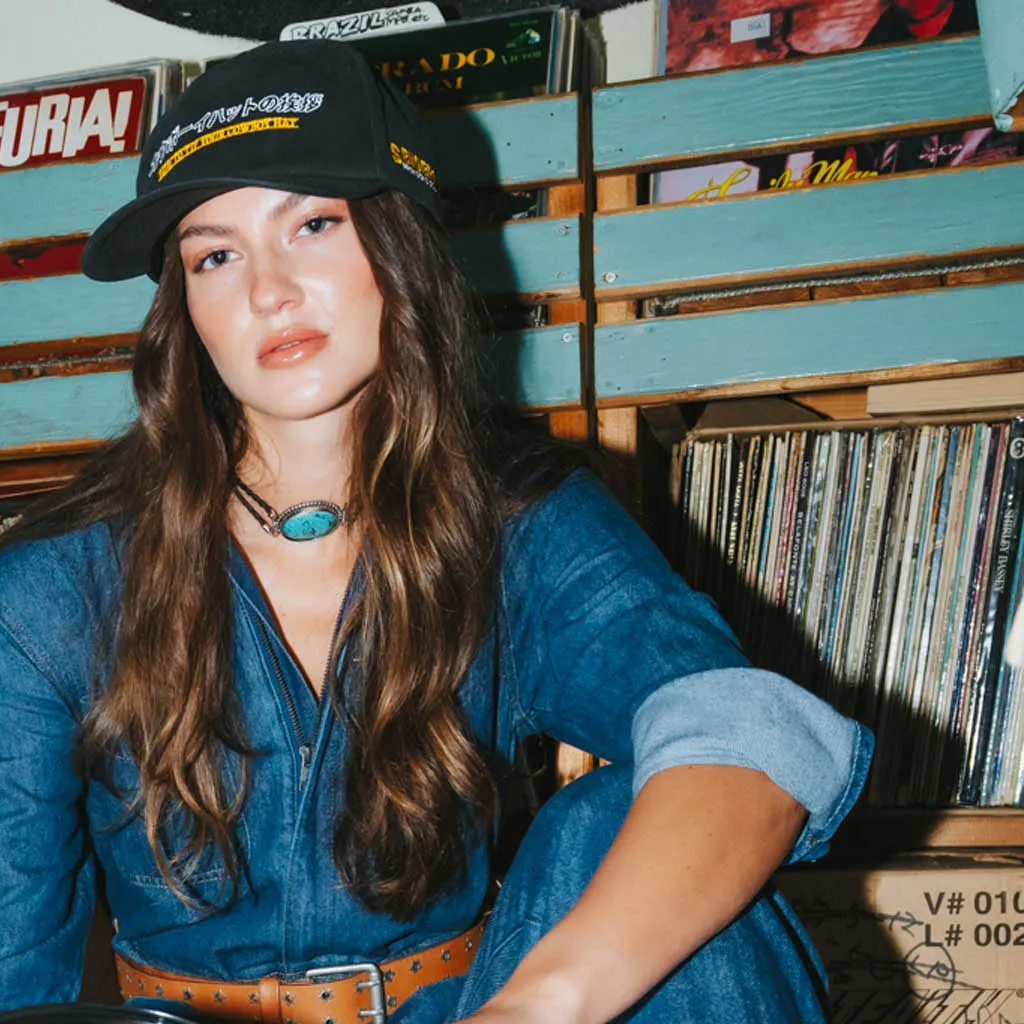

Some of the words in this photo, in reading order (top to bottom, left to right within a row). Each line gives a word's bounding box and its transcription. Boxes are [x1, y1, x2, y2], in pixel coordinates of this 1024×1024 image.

[291, 12, 386, 40] BRAZIL
[373, 47, 495, 77] RADO
[999, 508, 1013, 553] SHIRLEY
[994, 555, 1009, 594] BASSEY
[923, 891, 965, 916] V#
[925, 923, 963, 947] L#
